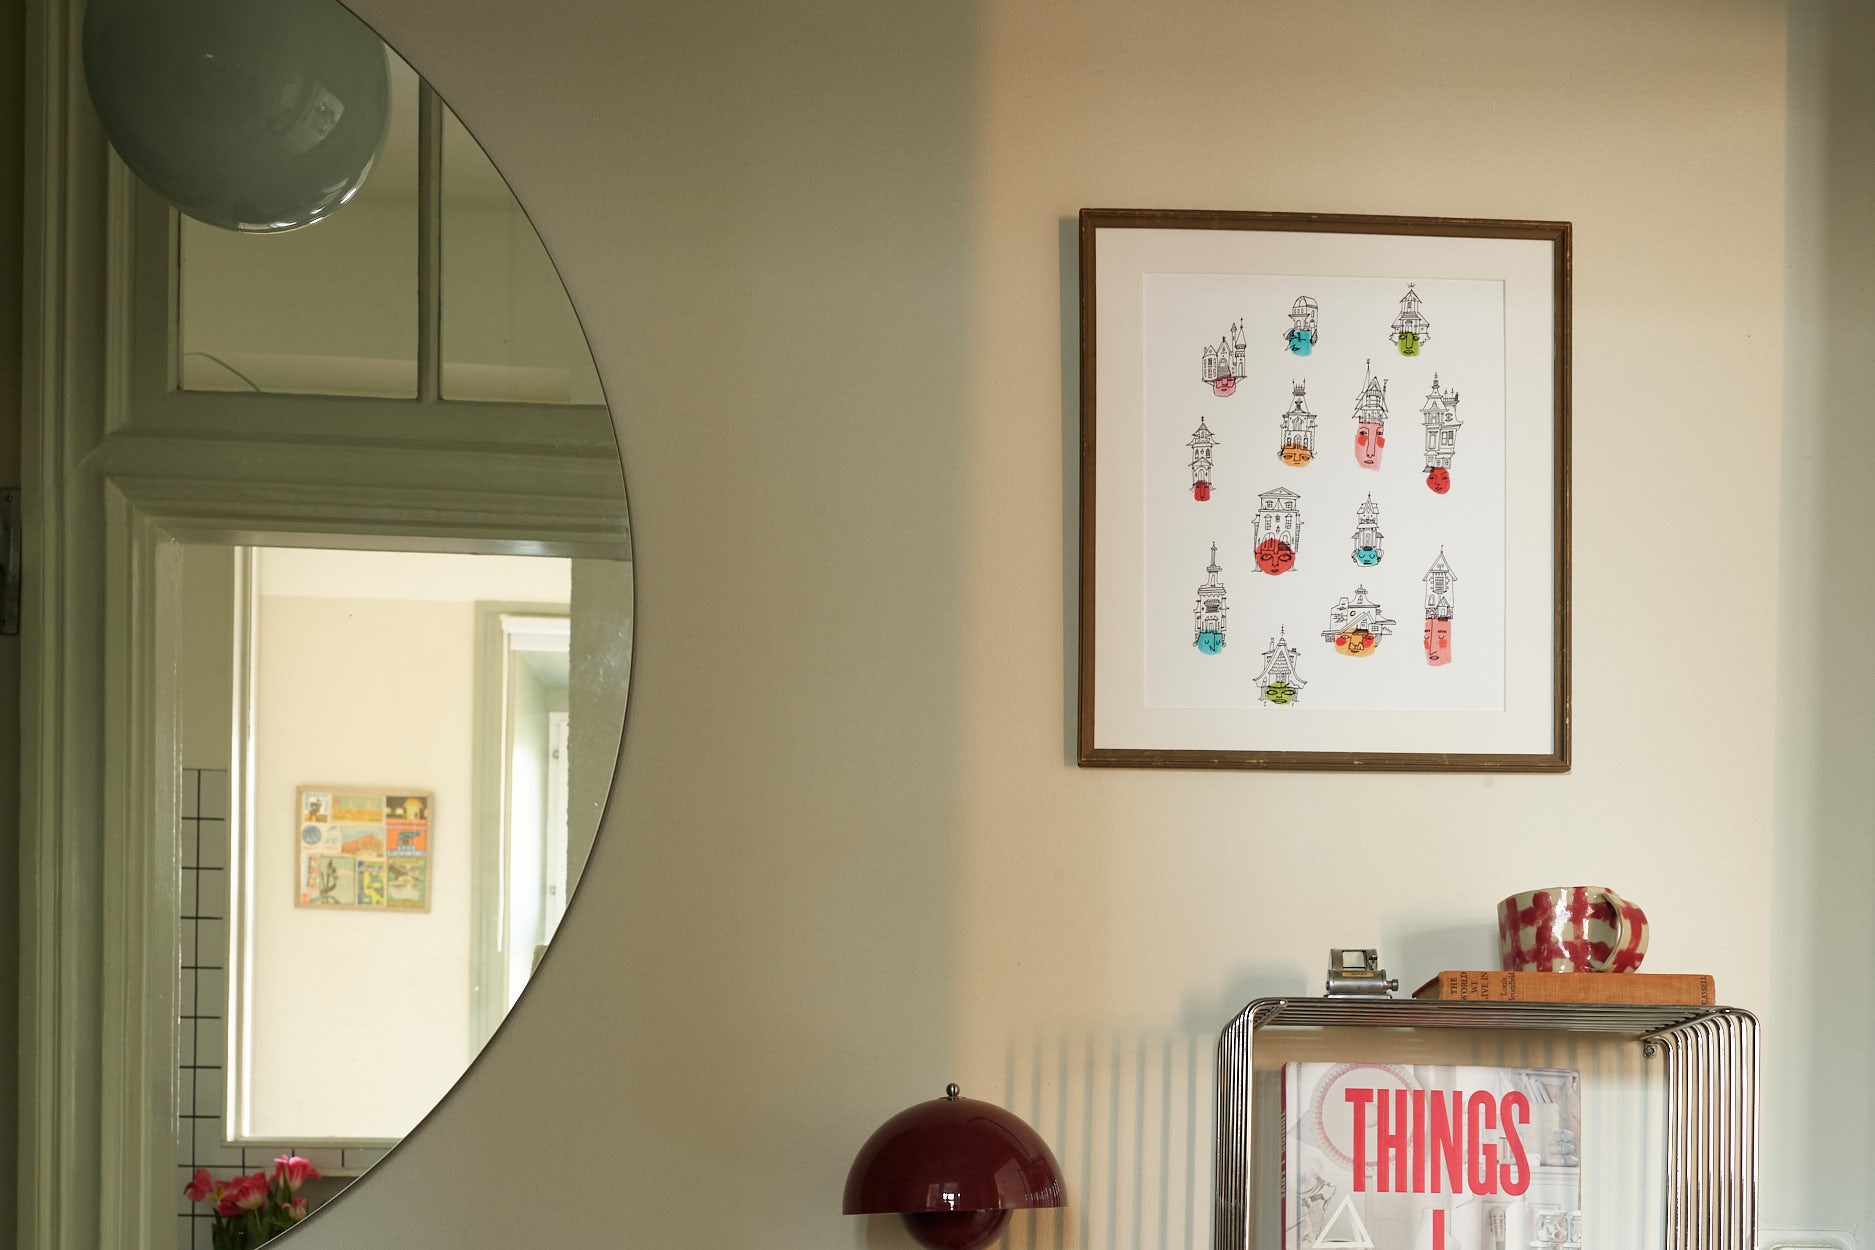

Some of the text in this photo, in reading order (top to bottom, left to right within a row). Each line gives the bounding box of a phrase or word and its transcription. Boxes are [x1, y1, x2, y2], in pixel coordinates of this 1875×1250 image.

[1481, 971, 1488, 980] IN
[1471, 980, 1478, 993] WE
[1344, 1087, 1531, 1197] THINGS
